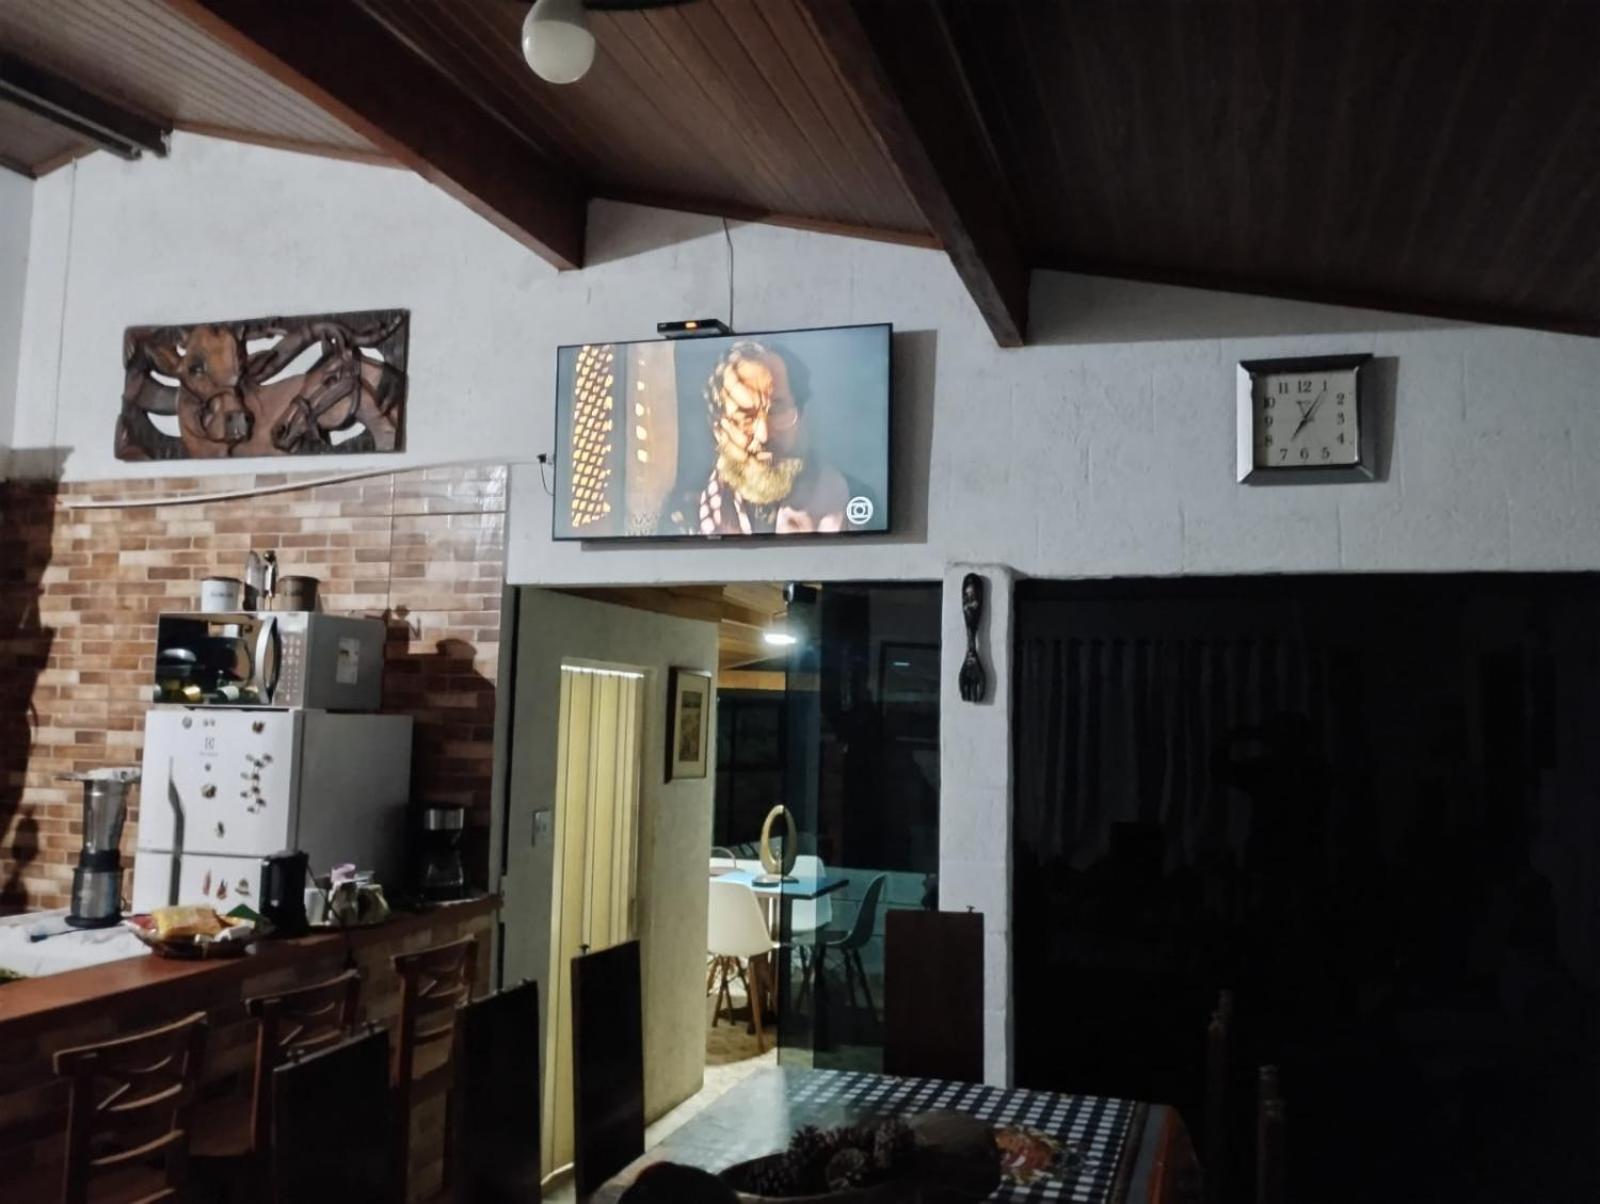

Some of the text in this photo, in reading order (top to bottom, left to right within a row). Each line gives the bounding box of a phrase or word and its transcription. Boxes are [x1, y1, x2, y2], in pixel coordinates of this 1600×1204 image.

[1279, 382, 1289, 394] 11
[1297, 381, 1312, 393] 12
[1263, 397, 1276, 409] 10
[1336, 393, 1345, 405] 2
[1265, 417, 1273, 426] 9
[1337, 413, 1345, 425] 3
[1337, 433, 1344, 444] 4
[1280, 449, 1288, 460] 7
[1300, 448, 1309, 459] 6
[1322, 447, 1330, 459] 5
